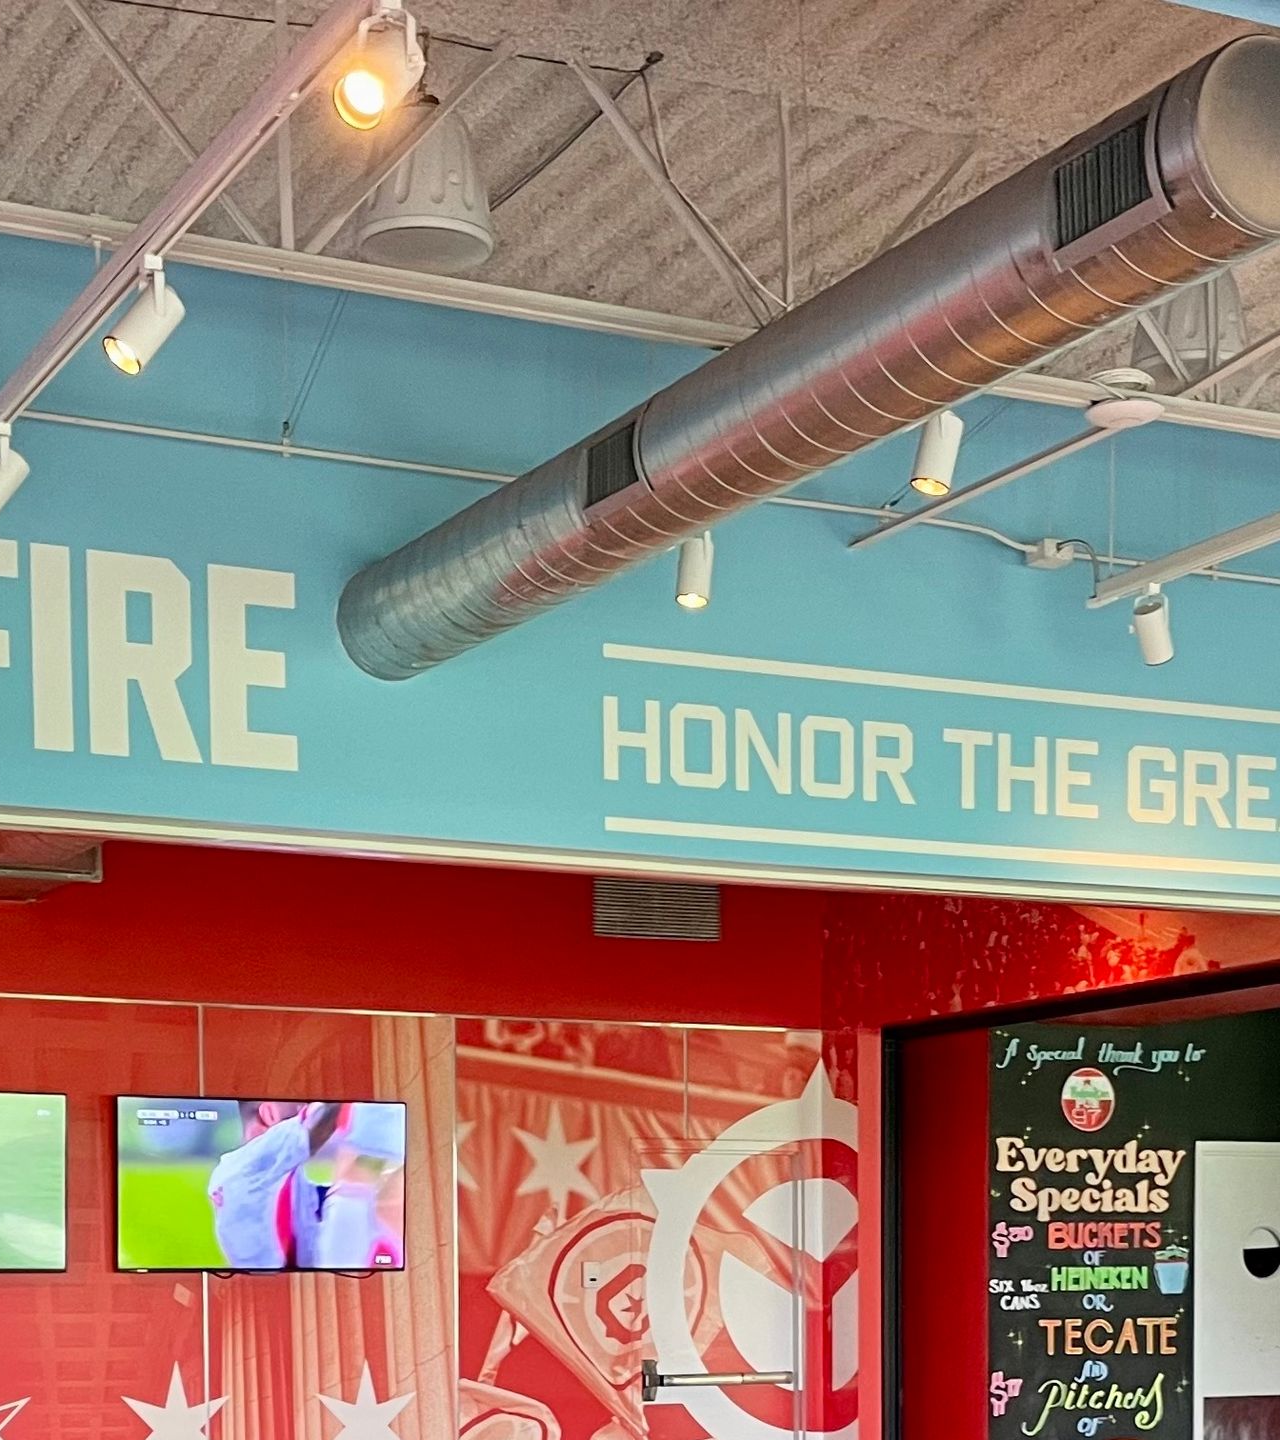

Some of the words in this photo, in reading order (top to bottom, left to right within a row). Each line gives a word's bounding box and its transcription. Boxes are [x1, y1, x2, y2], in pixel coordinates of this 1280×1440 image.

[603, 694, 916, 806] HONOR
[943, 728, 1099, 819] THE
[1026, 1036, 1085, 1070] Special
[1098, 1042, 1144, 1064] thank
[1184, 1043, 1207, 1062] to
[995, 1136, 1186, 1186] Everyday
[1009, 1176, 1170, 1222] Specials
[1048, 1221, 1162, 1250] BUCKETS
[1083, 1250, 1107, 1266] OF
[988, 1278, 1016, 1294] SIX
[1000, 1294, 1041, 1311] CANS
[1082, 1293, 1114, 1312] OR
[1038, 1317, 1178, 1356] TECATE
[1021, 1373, 1165, 1436] Pitchers
